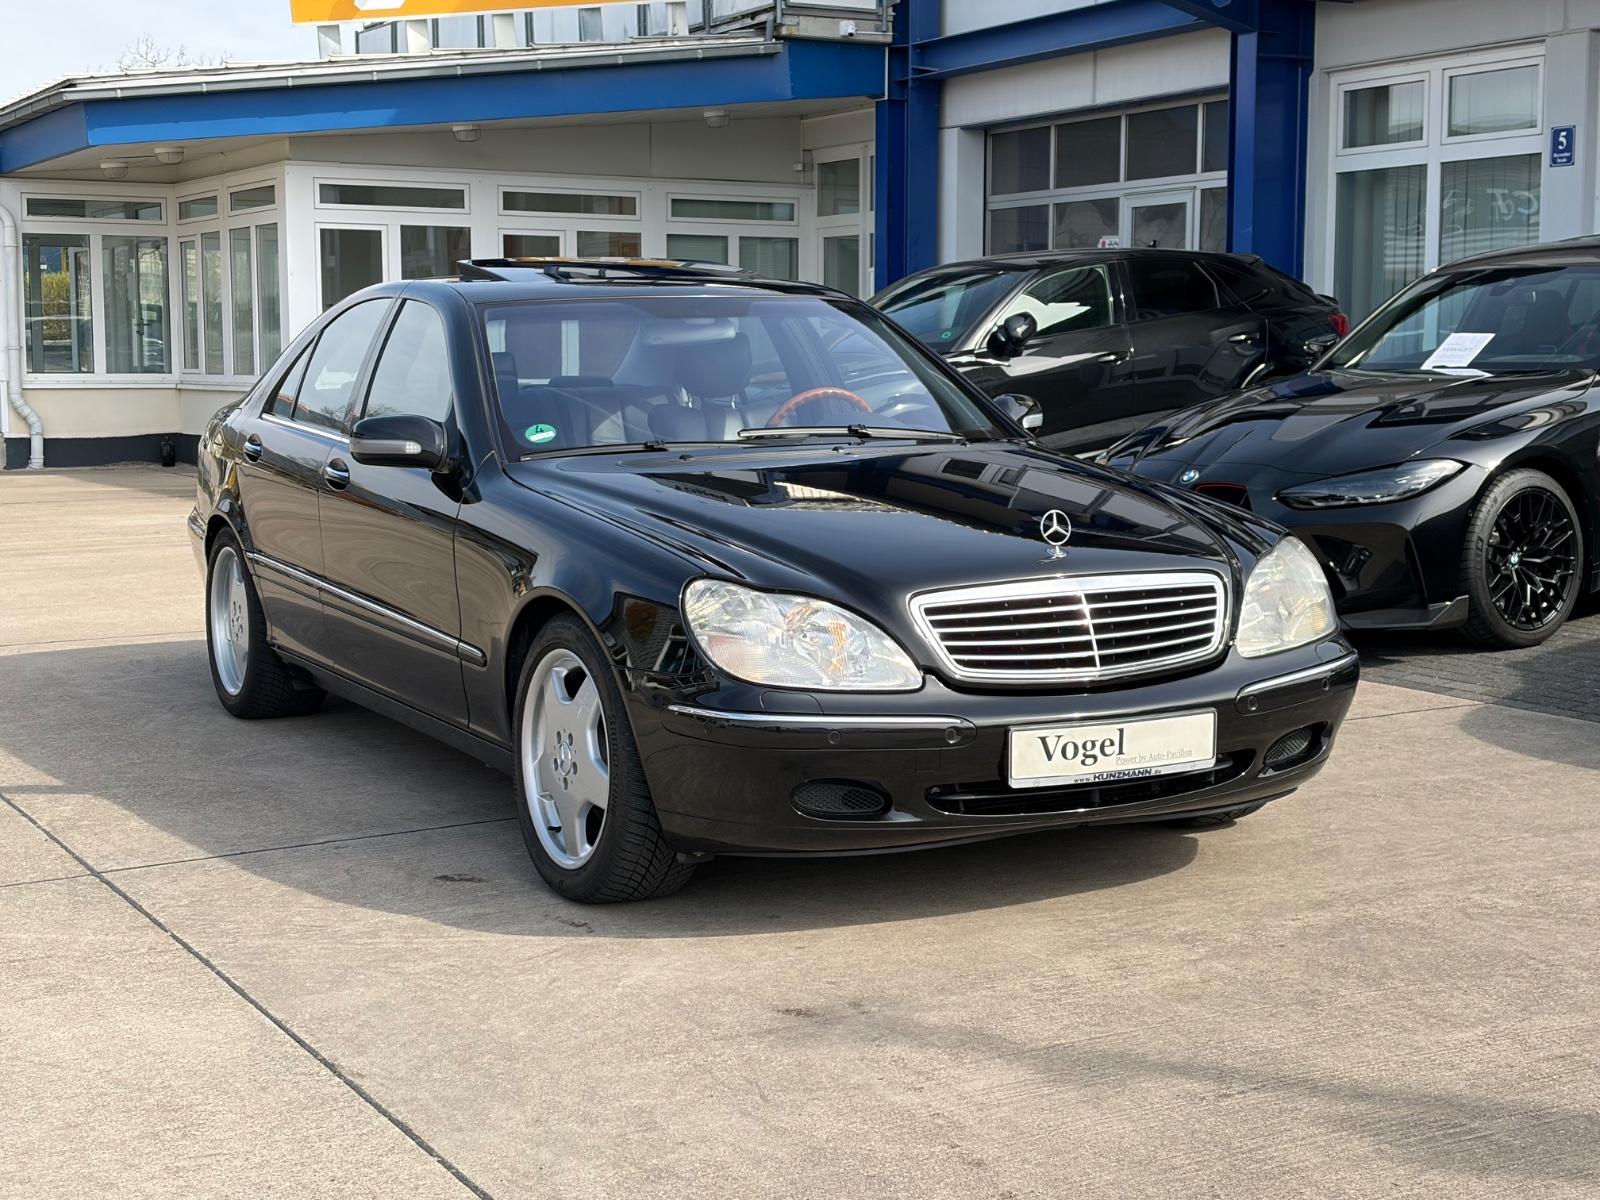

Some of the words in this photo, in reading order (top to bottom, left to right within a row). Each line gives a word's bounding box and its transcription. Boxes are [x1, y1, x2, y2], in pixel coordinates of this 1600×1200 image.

[1558, 131, 1567, 150] 5
[535, 425, 545, 433] 4
[1037, 728, 1126, 767] Vogel
[1116, 755, 1138, 765] Power
[1139, 753, 1147, 764] by
[1148, 748, 1193, 762] Auto-Pavillon
